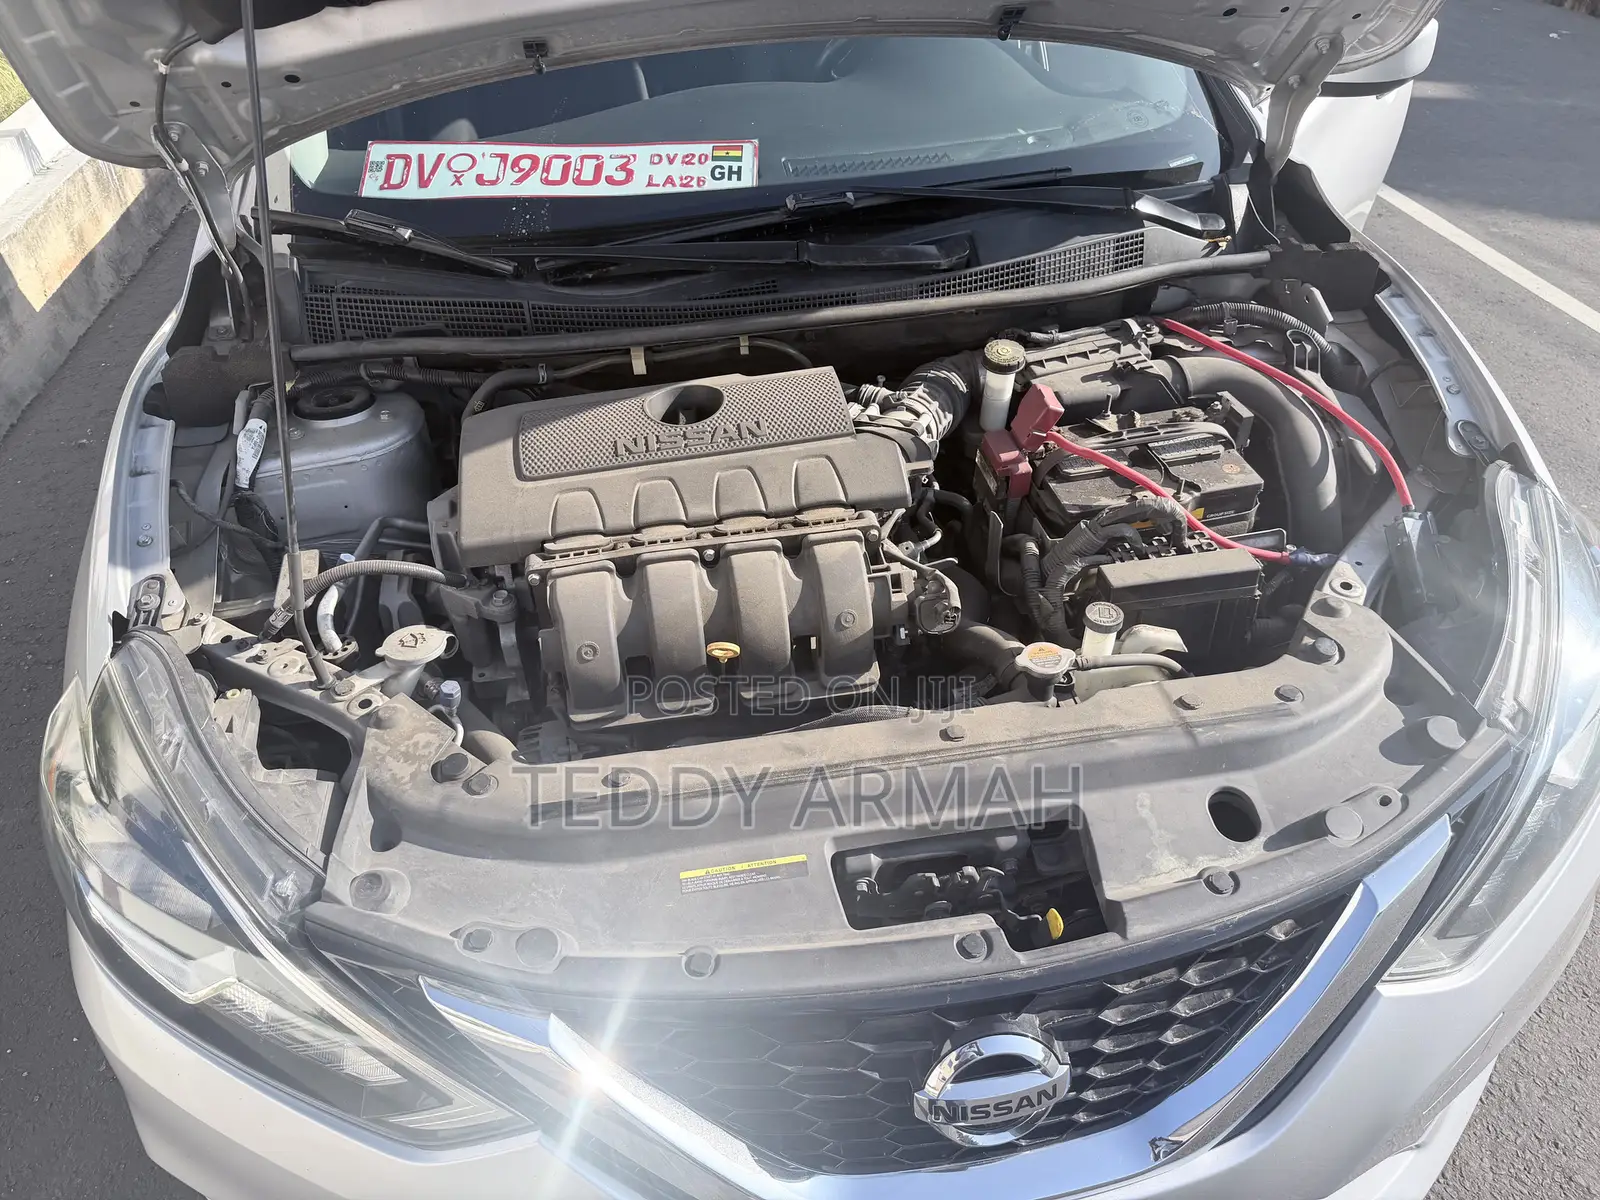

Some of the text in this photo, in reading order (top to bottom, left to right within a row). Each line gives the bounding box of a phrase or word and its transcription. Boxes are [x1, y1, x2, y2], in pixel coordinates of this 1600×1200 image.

[710, 164, 742, 182] GH
[614, 418, 768, 457] NISSAN
[710, 866, 736, 874] CAUTION
[747, 860, 777, 868] ATTENTION
[932, 1083, 1058, 1123] NISSAN
